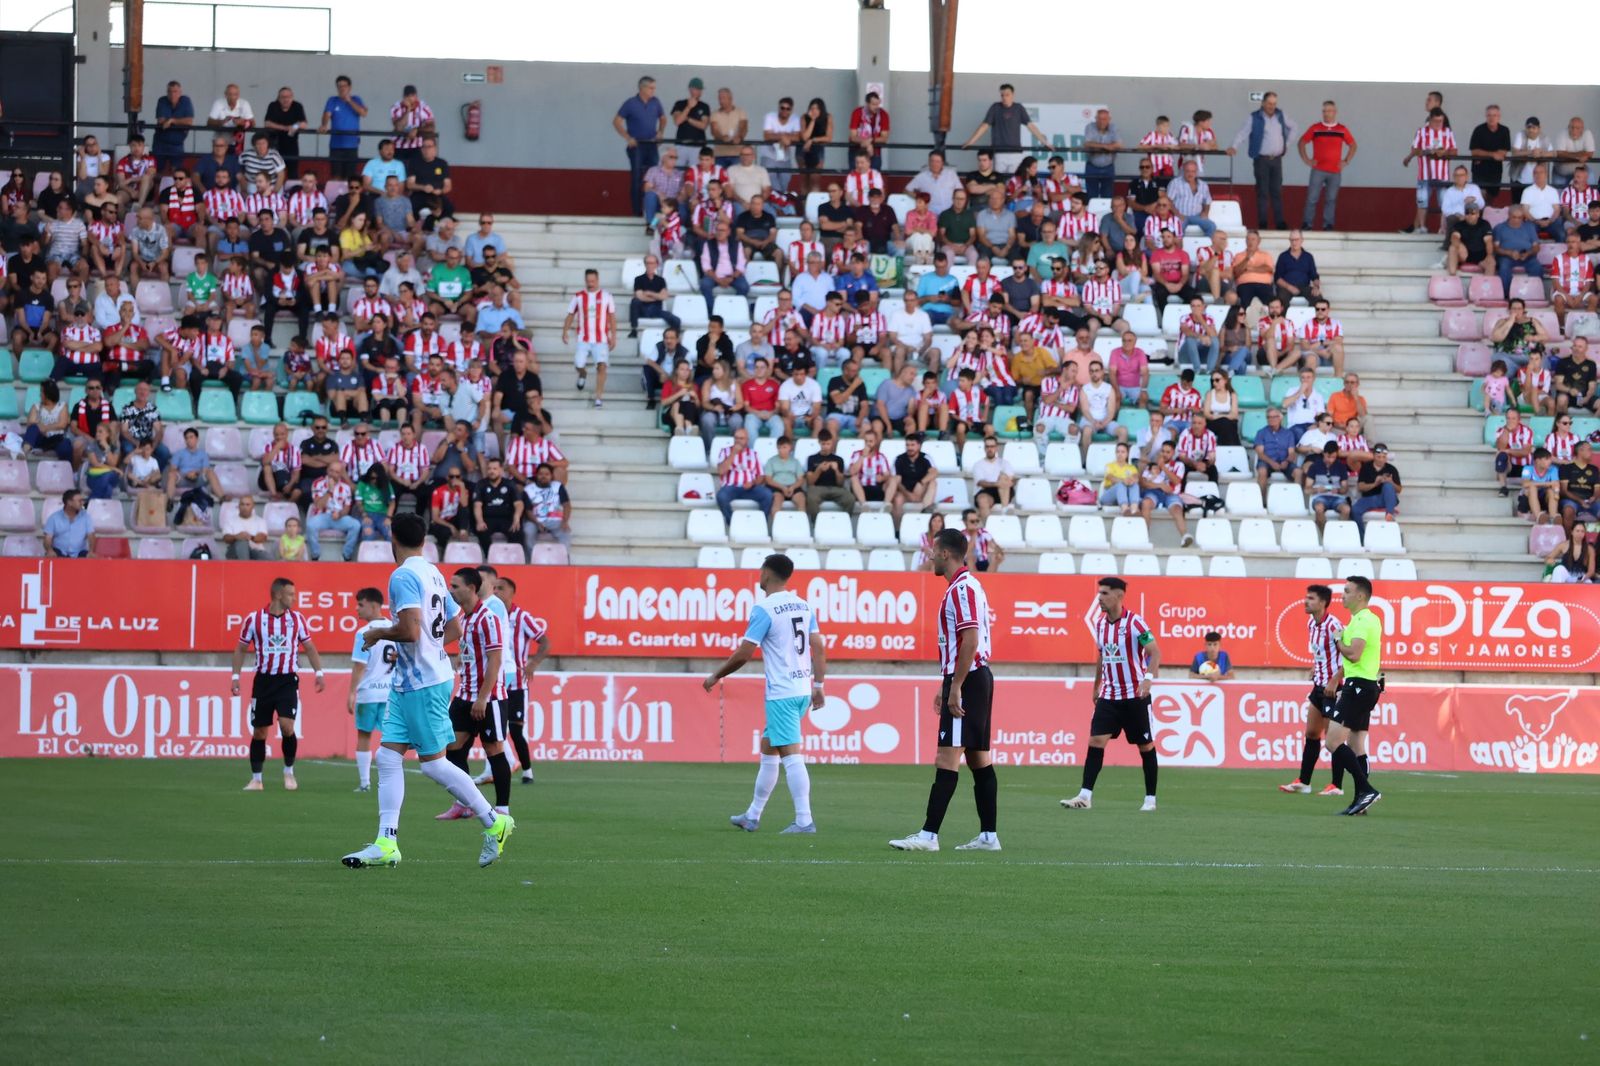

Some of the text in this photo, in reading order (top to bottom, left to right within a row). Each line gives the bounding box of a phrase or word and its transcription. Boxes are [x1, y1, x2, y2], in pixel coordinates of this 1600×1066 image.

[807, 575, 917, 624] Atilano
[1159, 603, 1207, 622] Grupo
[55, 616, 82, 629] DE
[87, 617, 113, 630] LA
[119, 617, 159, 631] LUZ
[1159, 621, 1257, 639] Leomotor
[584, 631, 623, 646] Pza.
[628, 632, 697, 647] Cuartel
[842, 635, 877, 649] 489
[881, 635, 916, 650] 002
[791, 617, 805, 655] 5
[382, 644, 397, 674] 9
[1449, 643, 1459, 656] Y
[1466, 643, 1572, 658] JAMONES
[17, 670, 304, 758] La Opinin
[992, 729, 1075, 745] Junta de
[38, 738, 272, 757] El Correo de Zamoa
[533, 744, 644, 761] de Zamora
[1013, 752, 1024, 766] y
[1029, 749, 1076, 765] León
